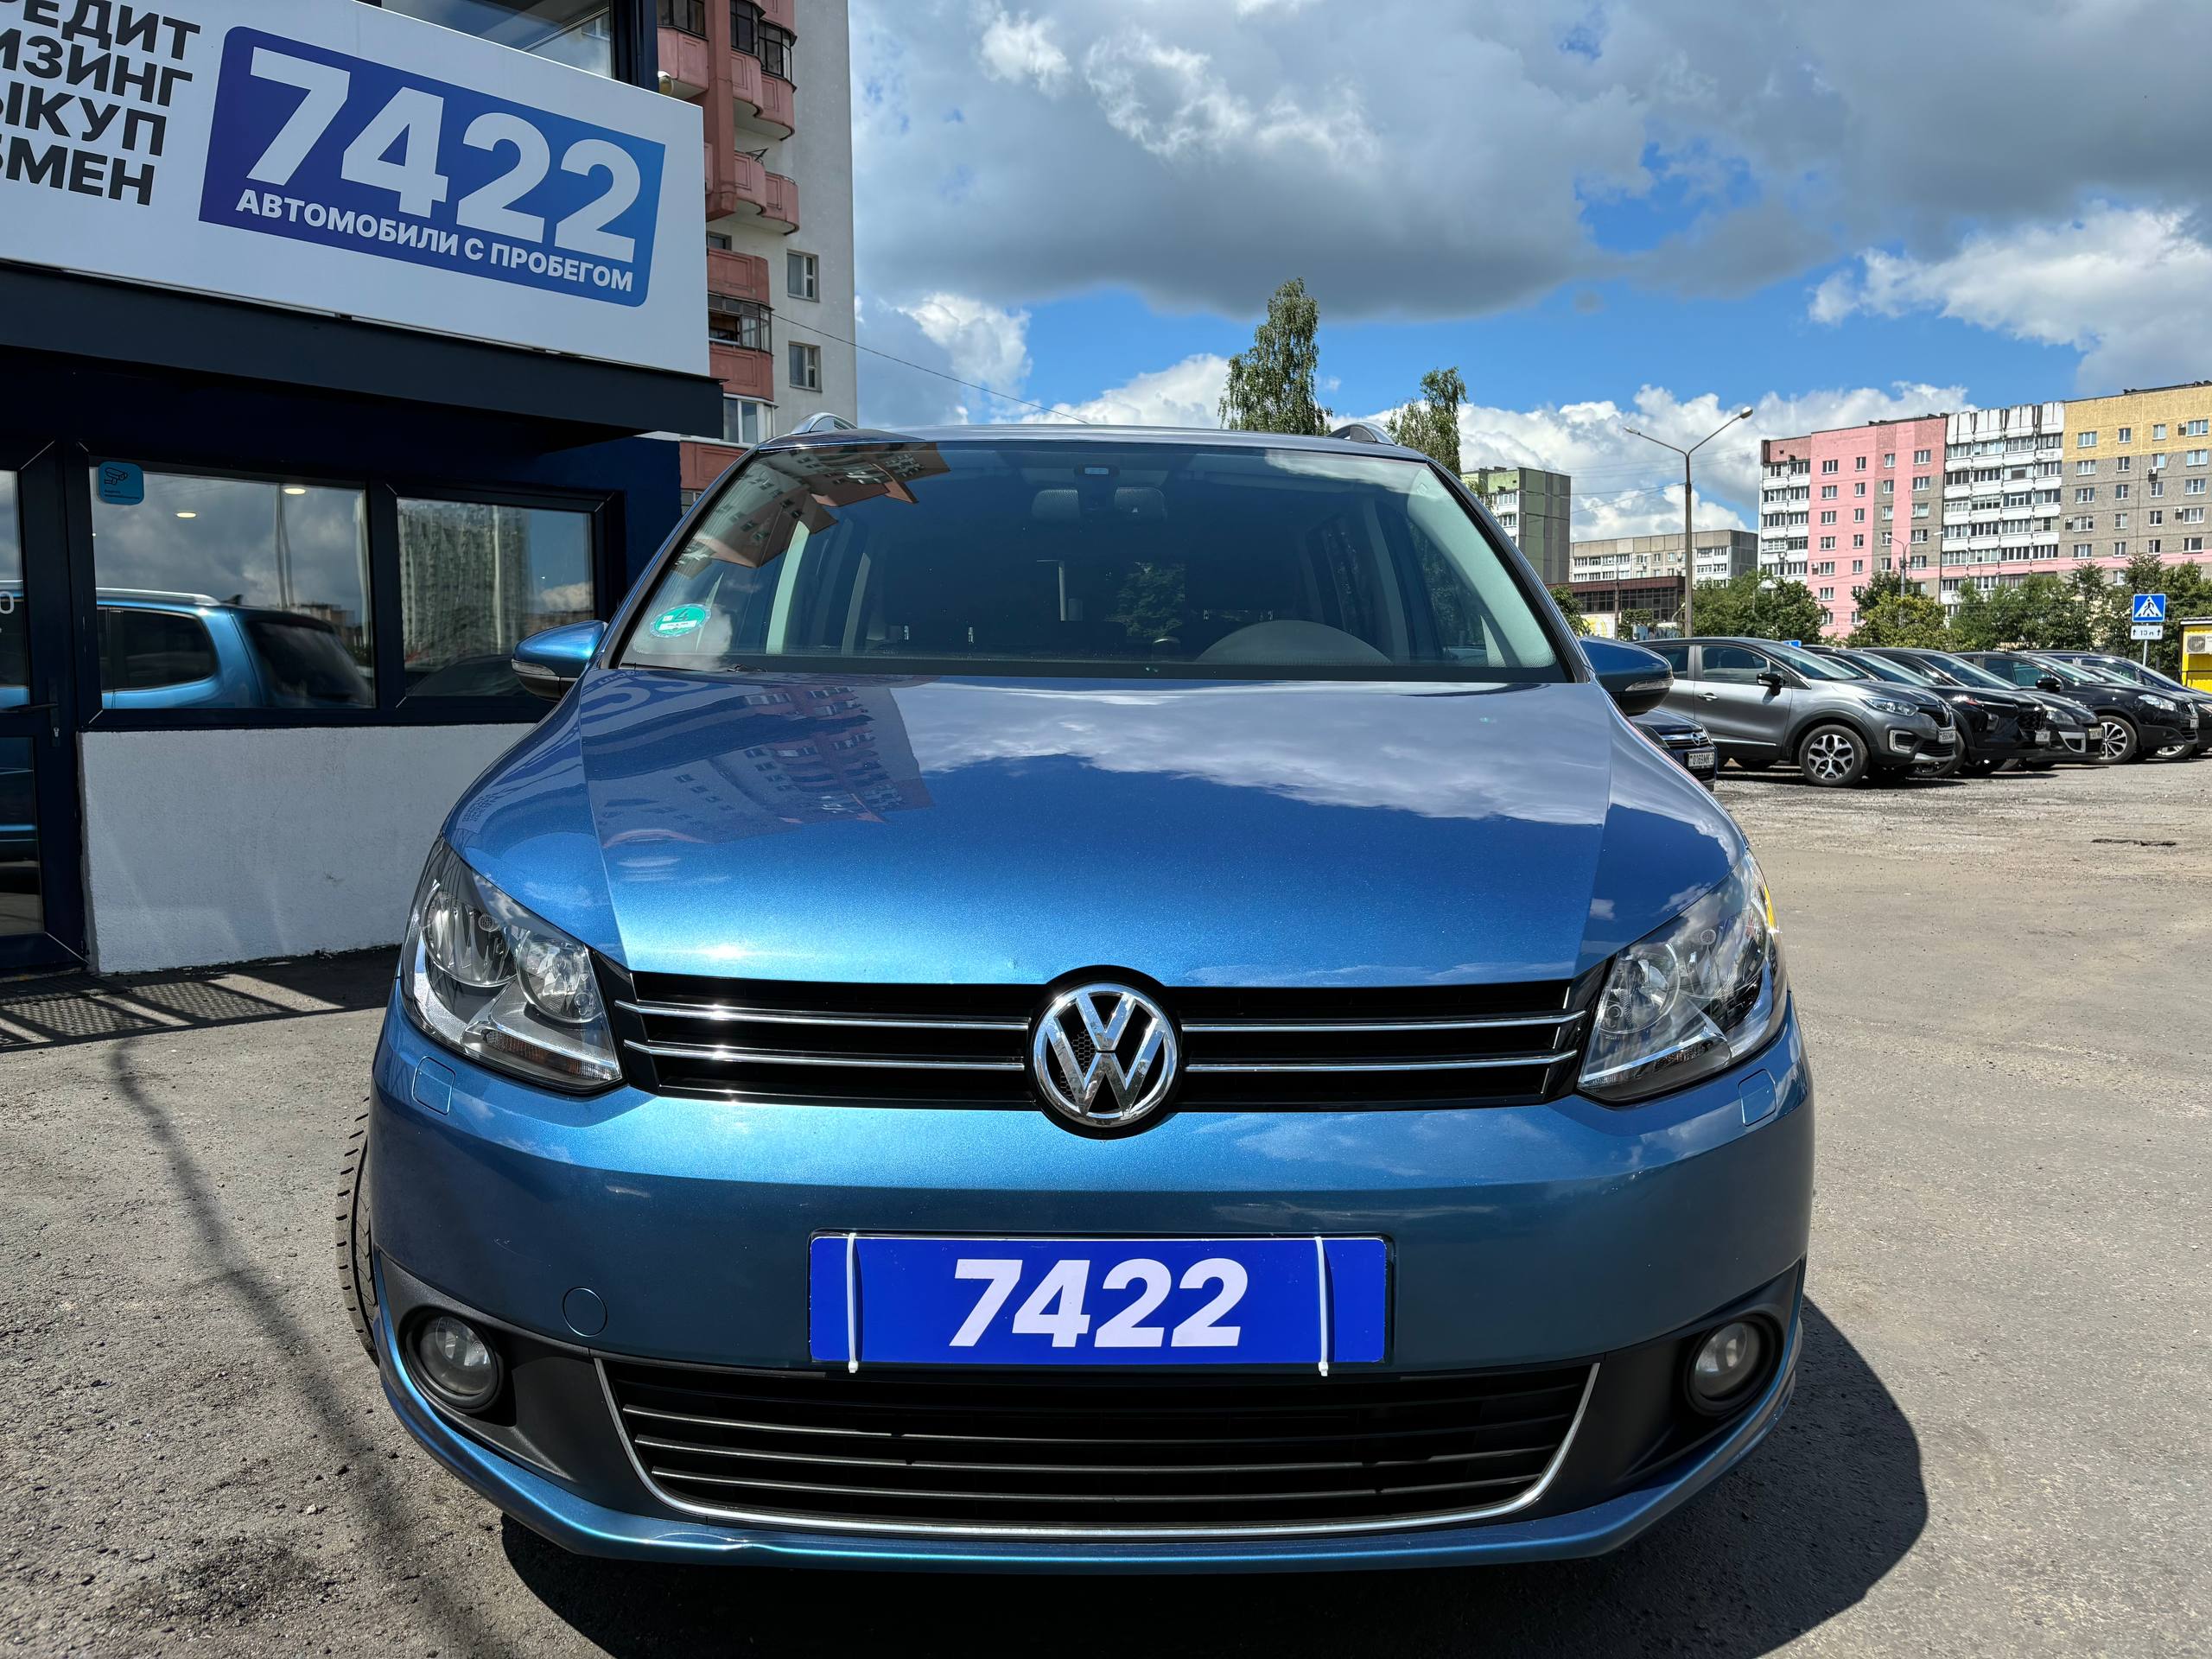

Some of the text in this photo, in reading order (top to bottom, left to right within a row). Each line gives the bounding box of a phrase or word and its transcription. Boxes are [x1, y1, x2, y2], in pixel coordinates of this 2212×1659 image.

[0, 0, 200, 60] ЕДИТ
[0, 133, 156, 207] МЕН
[245, 46, 641, 263] 7422
[235, 188, 633, 292] АВТОМОБИЛИ С ПРОБЕГОМ
[949, 1257, 1249, 1348] 7422
